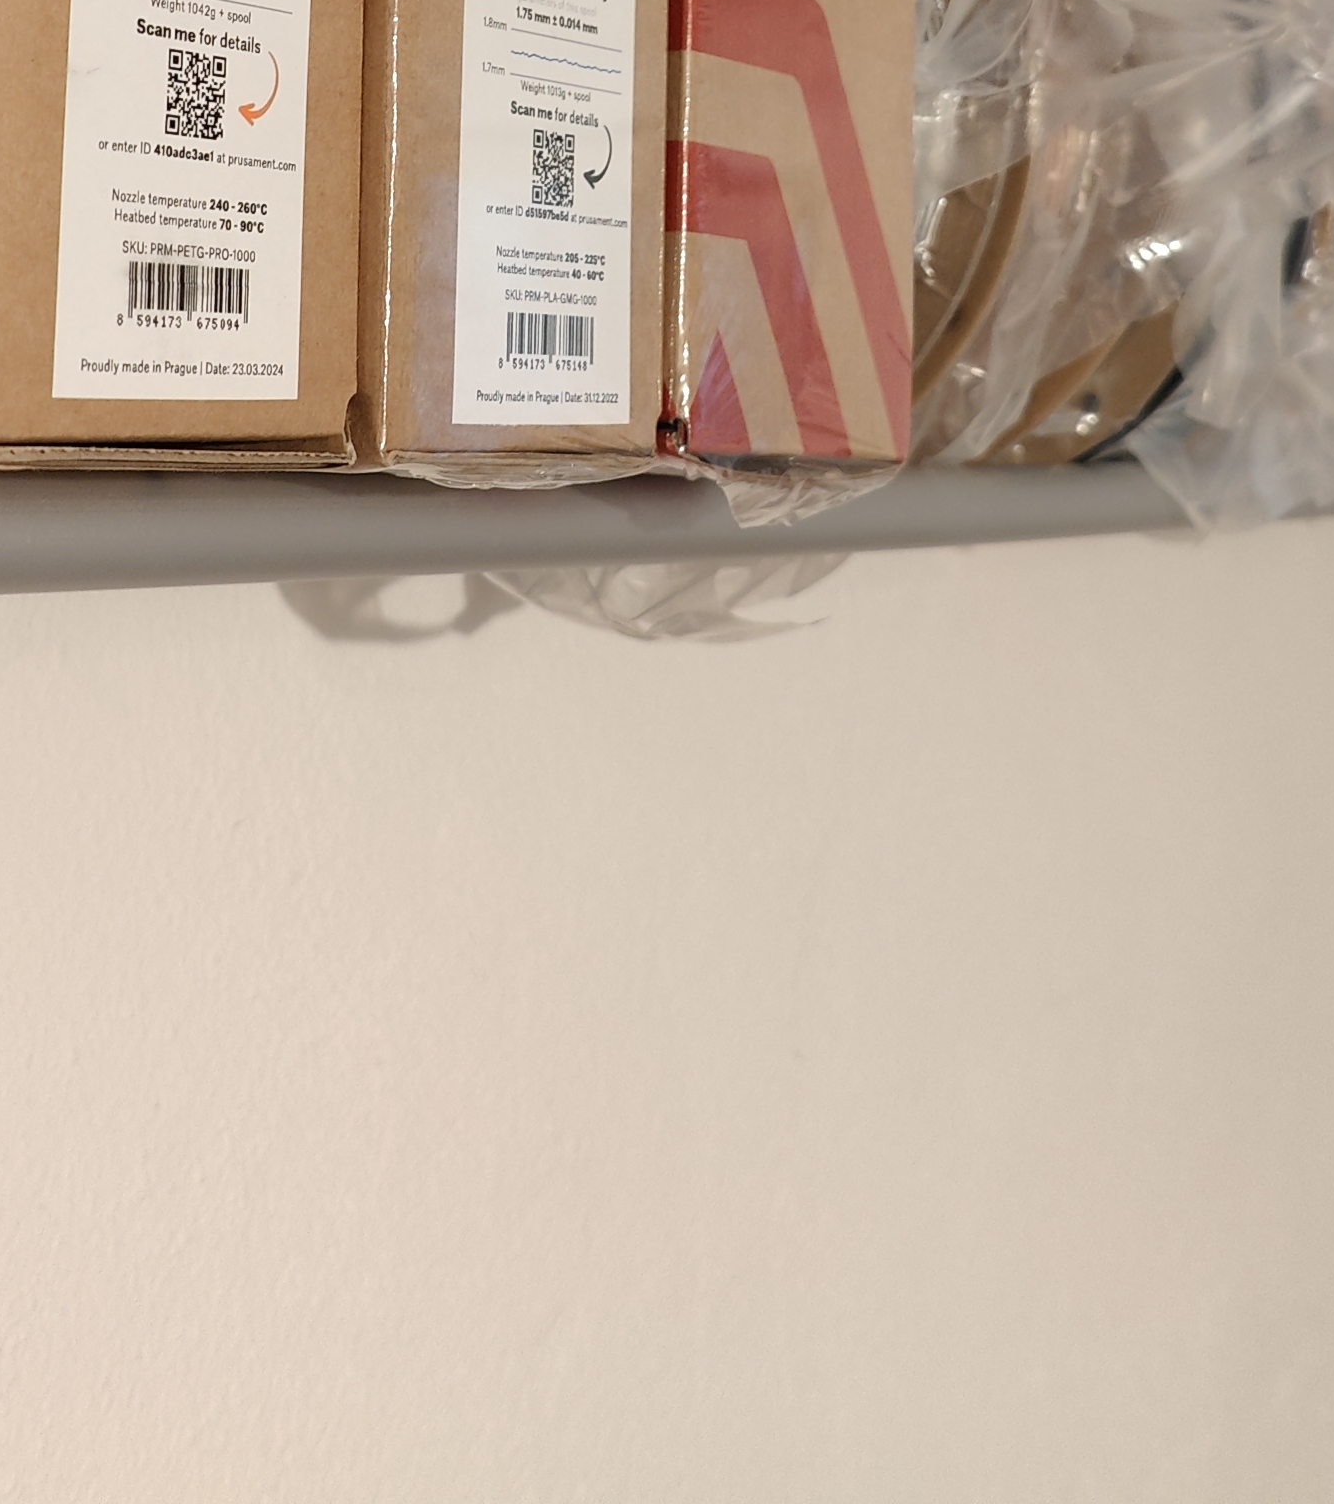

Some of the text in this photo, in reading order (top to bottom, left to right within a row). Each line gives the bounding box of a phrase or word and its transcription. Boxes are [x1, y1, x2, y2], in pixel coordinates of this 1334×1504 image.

[187, 1, 215, 20] 1042g
[219, 8, 224, 17] +
[227, 11, 251, 24] spool
[483, 16, 507, 31] 1.8mm
[516, 5, 533, 20] 1.75
[534, 12, 551, 24] mm
[582, 23, 598, 34] mm
[136, 18, 260, 54] Scan me for details
[482, 61, 505, 76] 1.7mm
[510, 100, 598, 128] Scan me for details
[98, 140, 109, 149] or
[111, 141, 137, 153] enter
[140, 141, 151, 154] ID
[216, 153, 225, 163] at
[227, 155, 296, 171] prusament.com
[111, 188, 145, 204] Nozzle
[148, 193, 207, 210] temperature
[209, 198, 229, 212] 240
[114, 208, 156, 224] Heatbed
[159, 214, 217, 229] temperature
[219, 218, 231, 231] 70
[122, 239, 255, 263] SKU: PRM-PETG-PRO-1000
[117, 314, 239, 330] 8 594173 675094
[80, 357, 119, 375] Proudly
[121, 359, 149, 373] made
[152, 360, 161, 373] in
[164, 360, 197, 376] Prague
[205, 361, 230, 375] Date:
[231, 362, 283, 376] 23.03.2024
[499, 357, 587, 371] 8 594173 675148
